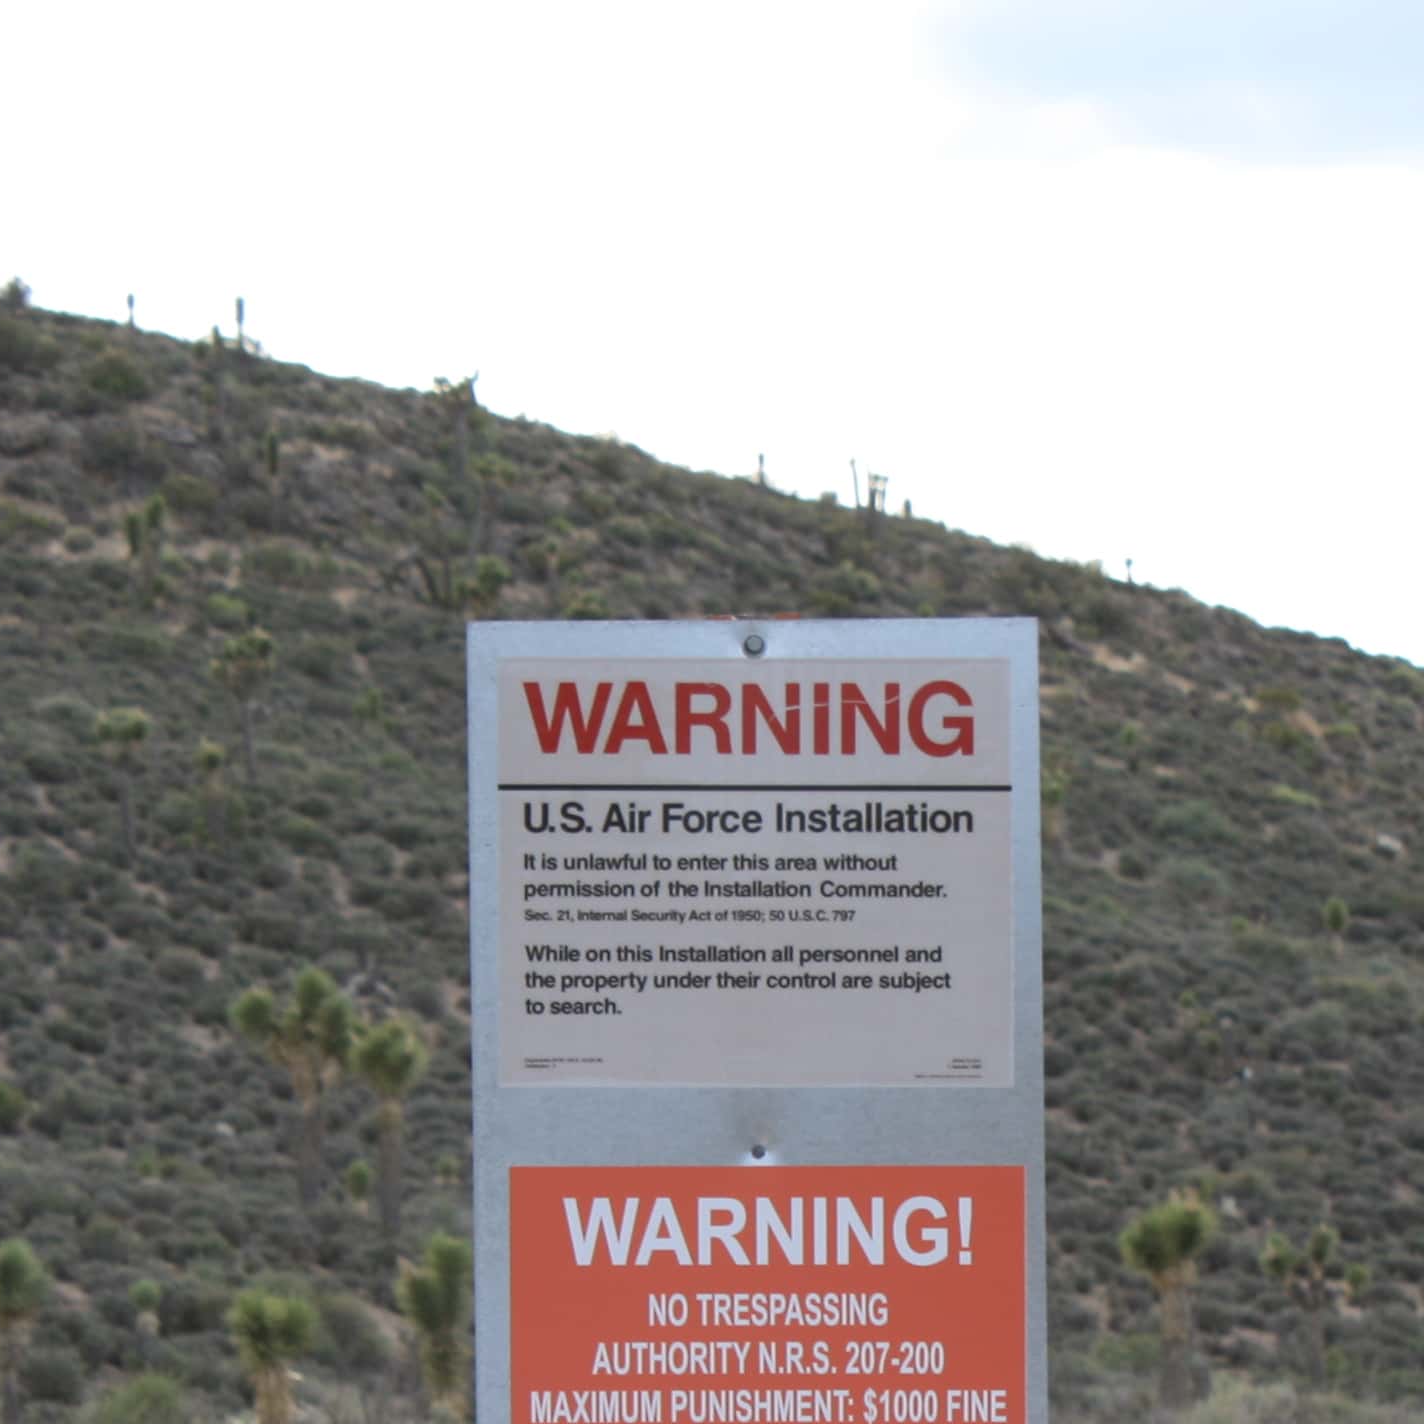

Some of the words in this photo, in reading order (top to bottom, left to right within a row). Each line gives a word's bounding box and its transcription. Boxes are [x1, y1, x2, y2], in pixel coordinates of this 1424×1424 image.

[522, 679, 975, 758] WARNING
[523, 801, 593, 834] U.S.
[601, 802, 652, 833] Air
[662, 802, 763, 834] Force
[776, 802, 974, 834] Installation
[523, 853, 536, 871] It
[540, 852, 558, 871] is
[563, 853, 647, 871] unlawful
[652, 854, 673, 871] to
[676, 854, 729, 871] enter
[732, 853, 770, 871] this
[774, 857, 818, 872] area
[823, 853, 897, 872] without
[523, 879, 636, 902] permission
[639, 879, 661, 898] of
[667, 880, 699, 898] the
[704, 880, 812, 898] Installation
[819, 879, 947, 899] Commander.
[524, 908, 553, 923] Sec.
[577, 908, 628, 923] Internal
[631, 908, 685, 926] Security
[688, 908, 712, 923] Act
[714, 908, 730, 923] of
[769, 908, 785, 923] 50
[831, 908, 857, 923] 797
[524, 944, 581, 963] While
[585, 948, 612, 963] on
[615, 945, 654, 963] this
[659, 945, 767, 963] Installation
[771, 945, 794, 963] all
[799, 945, 899, 967] personnel
[904, 945, 943, 963] and
[524, 970, 557, 989] the
[560, 971, 648, 993] property
[653, 971, 712, 989] under
[715, 971, 761, 989] their
[765, 971, 837, 989] control
[841, 975, 873, 989] are
[879, 971, 951, 993] subject
[524, 998, 546, 1015] to
[549, 997, 622, 1016] search.
[562, 1195, 973, 1267] WARNING!
[648, 1292, 689, 1327] NO
[695, 1292, 889, 1327] TRESPASSING
[591, 1341, 751, 1376] AUTHORITY
[758, 1340, 837, 1375] N.R.S.
[845, 1341, 945, 1375] 207-200
[530, 1389, 662, 1424] MAXIMUM
[671, 1389, 854, 1423] PUNISHMENT:
[946, 1389, 1007, 1423] FINE
